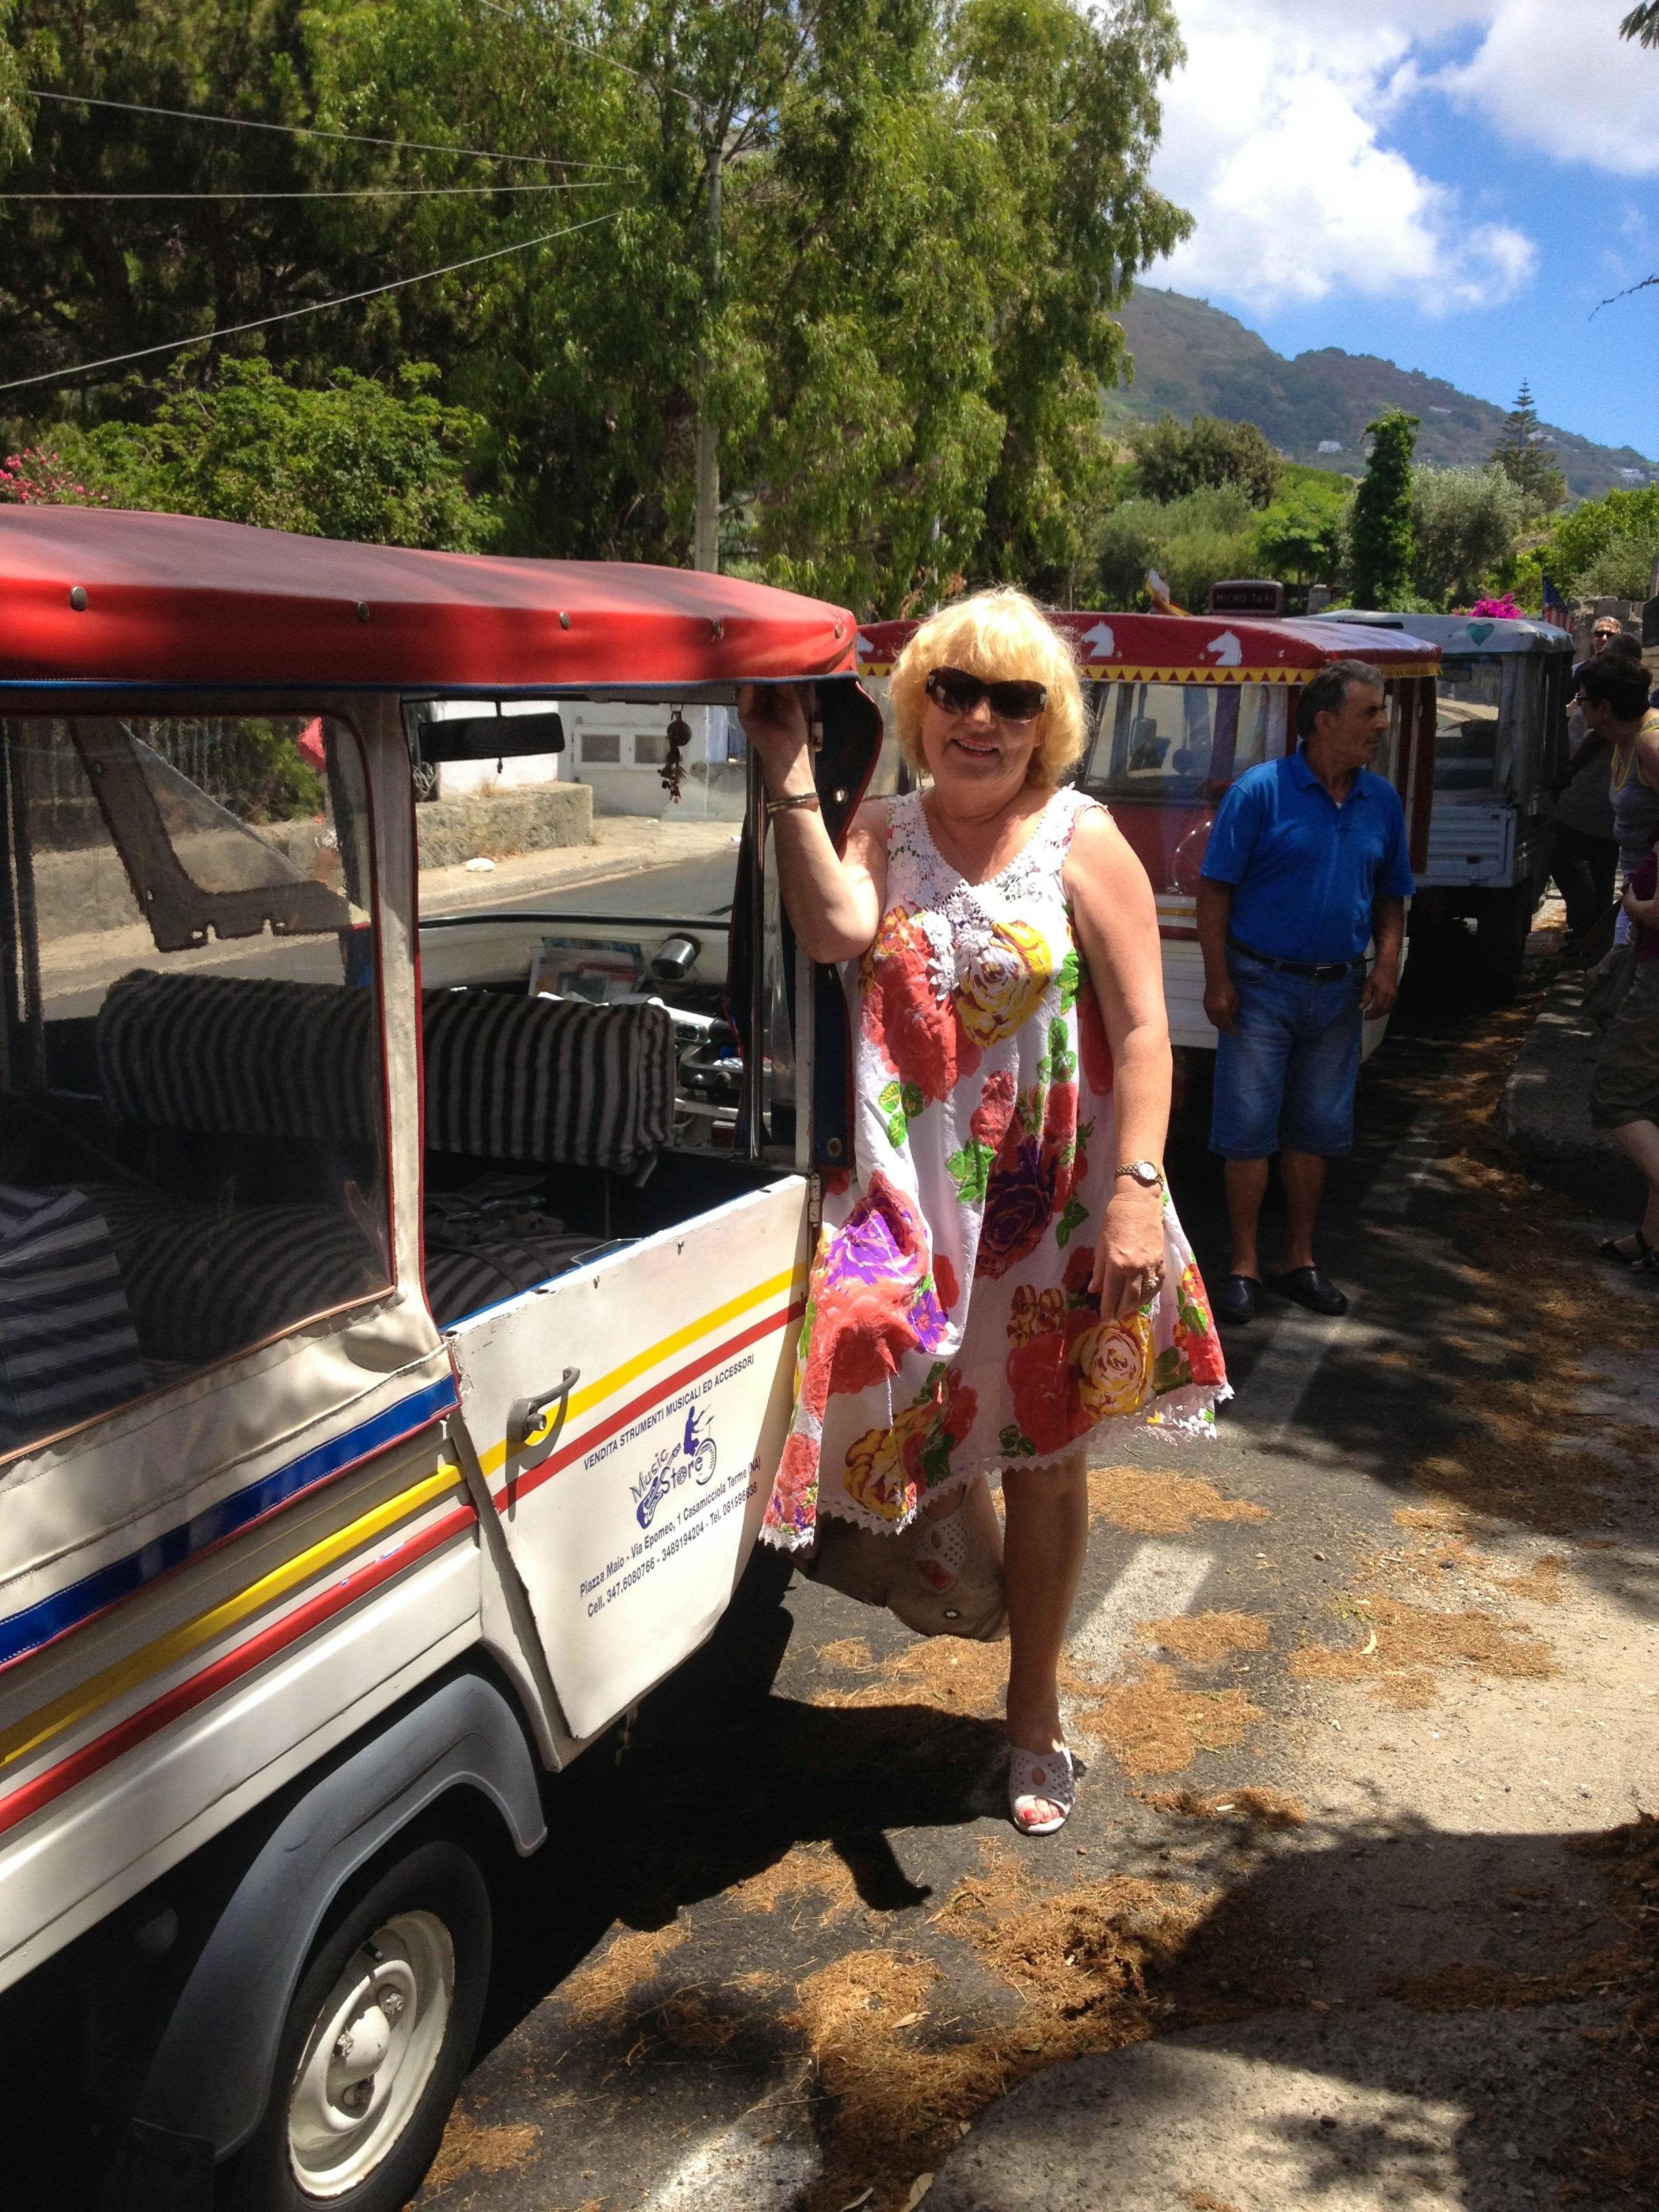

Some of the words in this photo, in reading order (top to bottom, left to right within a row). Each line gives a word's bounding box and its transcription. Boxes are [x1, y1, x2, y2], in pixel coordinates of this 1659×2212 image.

[1216, 592, 1247, 603] MICRO
[1252, 592, 1273, 603] TAXI
[583, 1439, 618, 1471] VENDITA
[620, 1408, 664, 1447] STRUMENTI
[665, 1385, 701, 1417] MUSICALI
[702, 1378, 713, 1394] ED
[714, 1353, 754, 1387] ACCESSORI
[630, 1448, 670, 1504] Music
[660, 1456, 703, 1494] Store
[580, 1572, 605, 1598] Piazza
[606, 1557, 624, 1578] Maio
[631, 1542, 643, 1558] Via
[644, 1521, 676, 1549] Epomeo,
[678, 1512, 681, 1525] 1
[683, 1483, 726, 1521] Casamicciola
[727, 1469, 747, 1489] Terme
[748, 1456, 761, 1477] (NA)
[588, 1595, 605, 1618] Cell.
[607, 1557, 655, 1603] 347.6080766
[661, 1521, 704, 1561] 3489194204
[710, 1509, 722, 1525] Tel.
